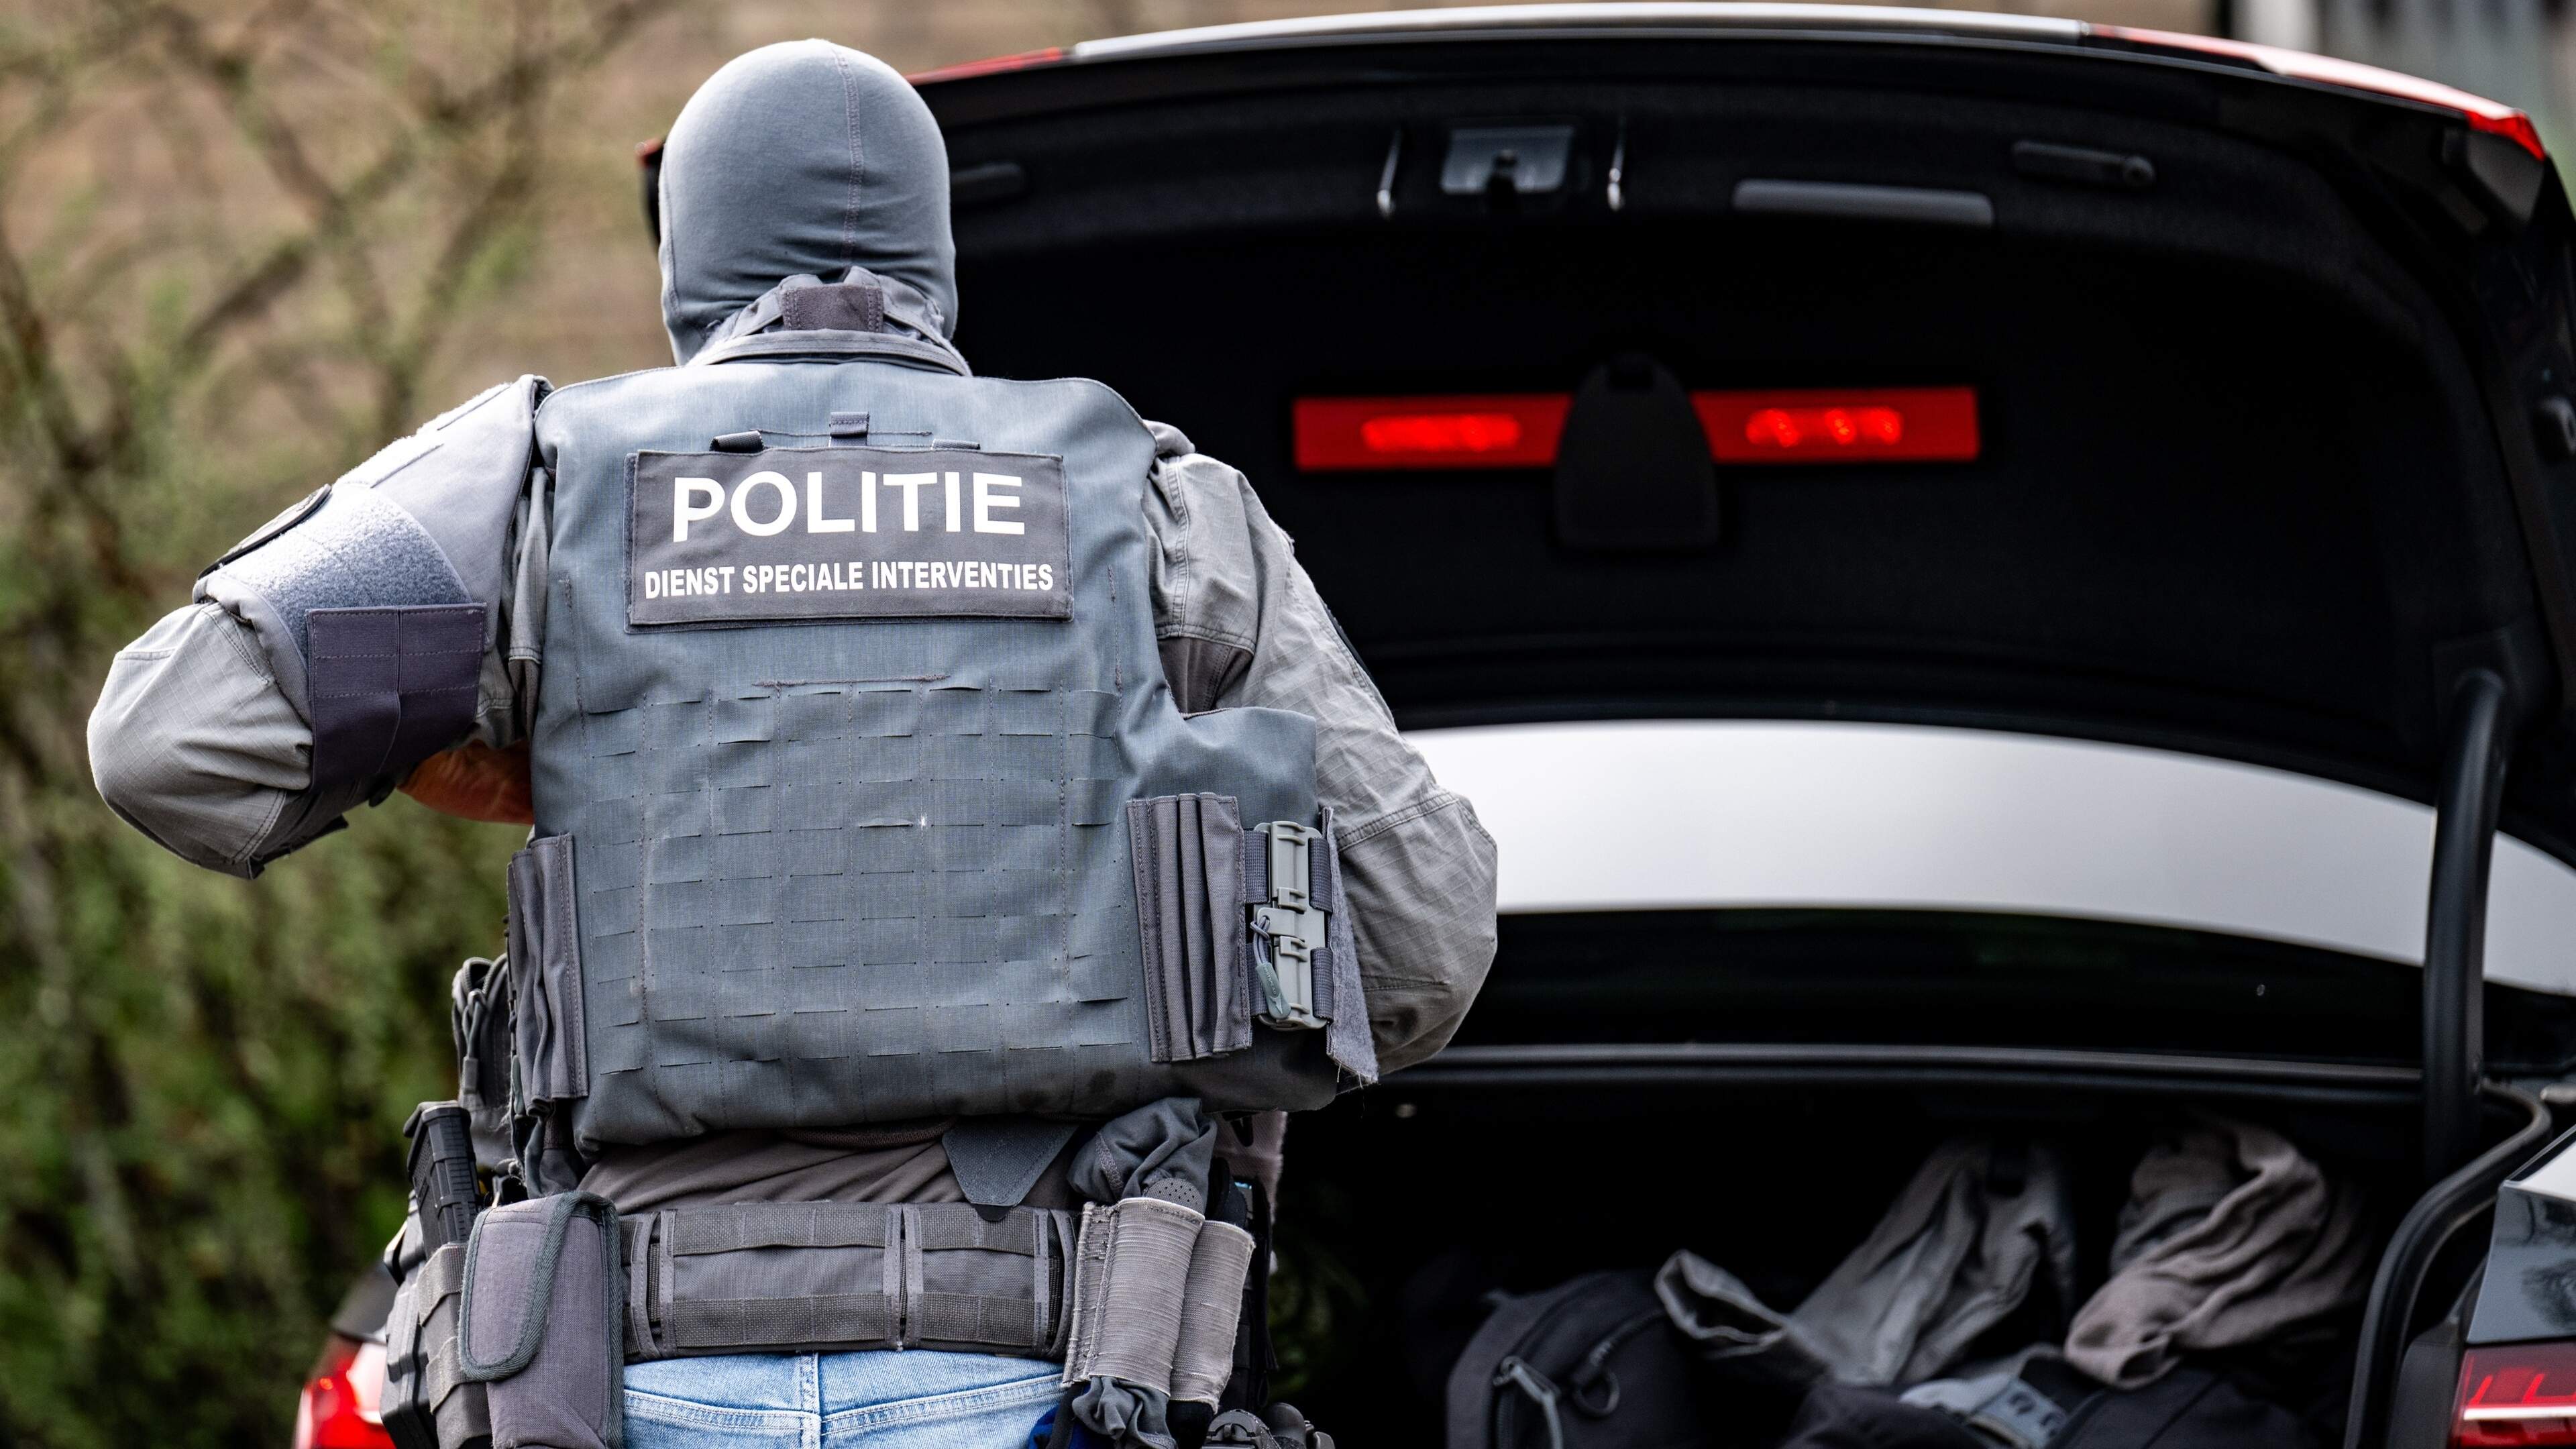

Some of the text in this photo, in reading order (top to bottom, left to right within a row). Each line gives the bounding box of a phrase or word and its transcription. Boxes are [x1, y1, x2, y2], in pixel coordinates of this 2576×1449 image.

[673, 471, 1025, 543] POLITIE
[645, 561, 1054, 600] DIENST SPECIALE INTERVENTIES
